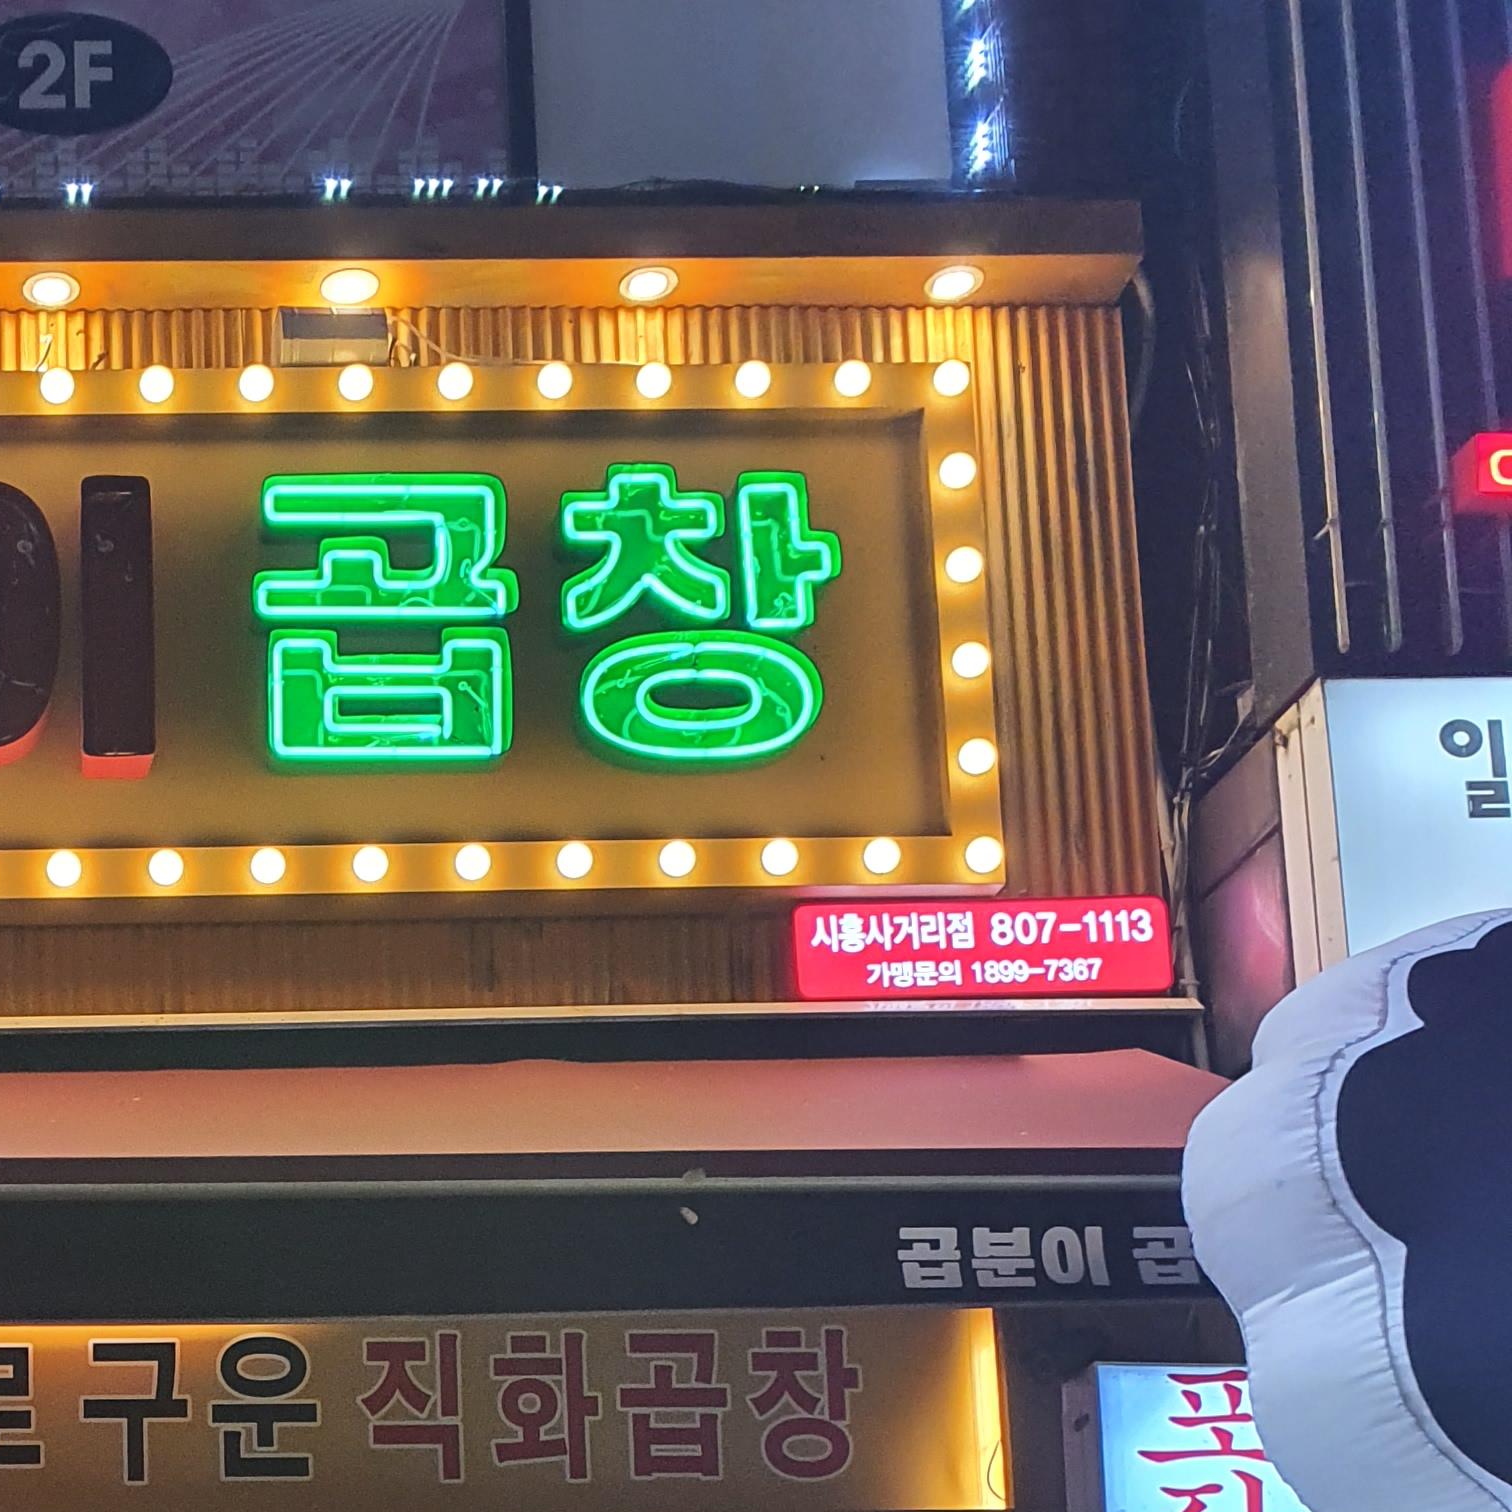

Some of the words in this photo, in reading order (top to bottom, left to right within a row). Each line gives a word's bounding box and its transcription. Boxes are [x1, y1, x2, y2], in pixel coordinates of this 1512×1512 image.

[17, 39, 114, 110] 2F
[253, 463, 842, 776] 곱창
[811, 911, 975, 953] 시흥사거리점
[990, 908, 1153, 946] 807-1113
[866, 959, 963, 987] 가맹문의
[971, 957, 1103, 984] 1899-7367
[897, 1226, 1111, 1288] 곱분이
[79, 1331, 321, 1486] 구운
[357, 1325, 862, 1484] 직화곱창
